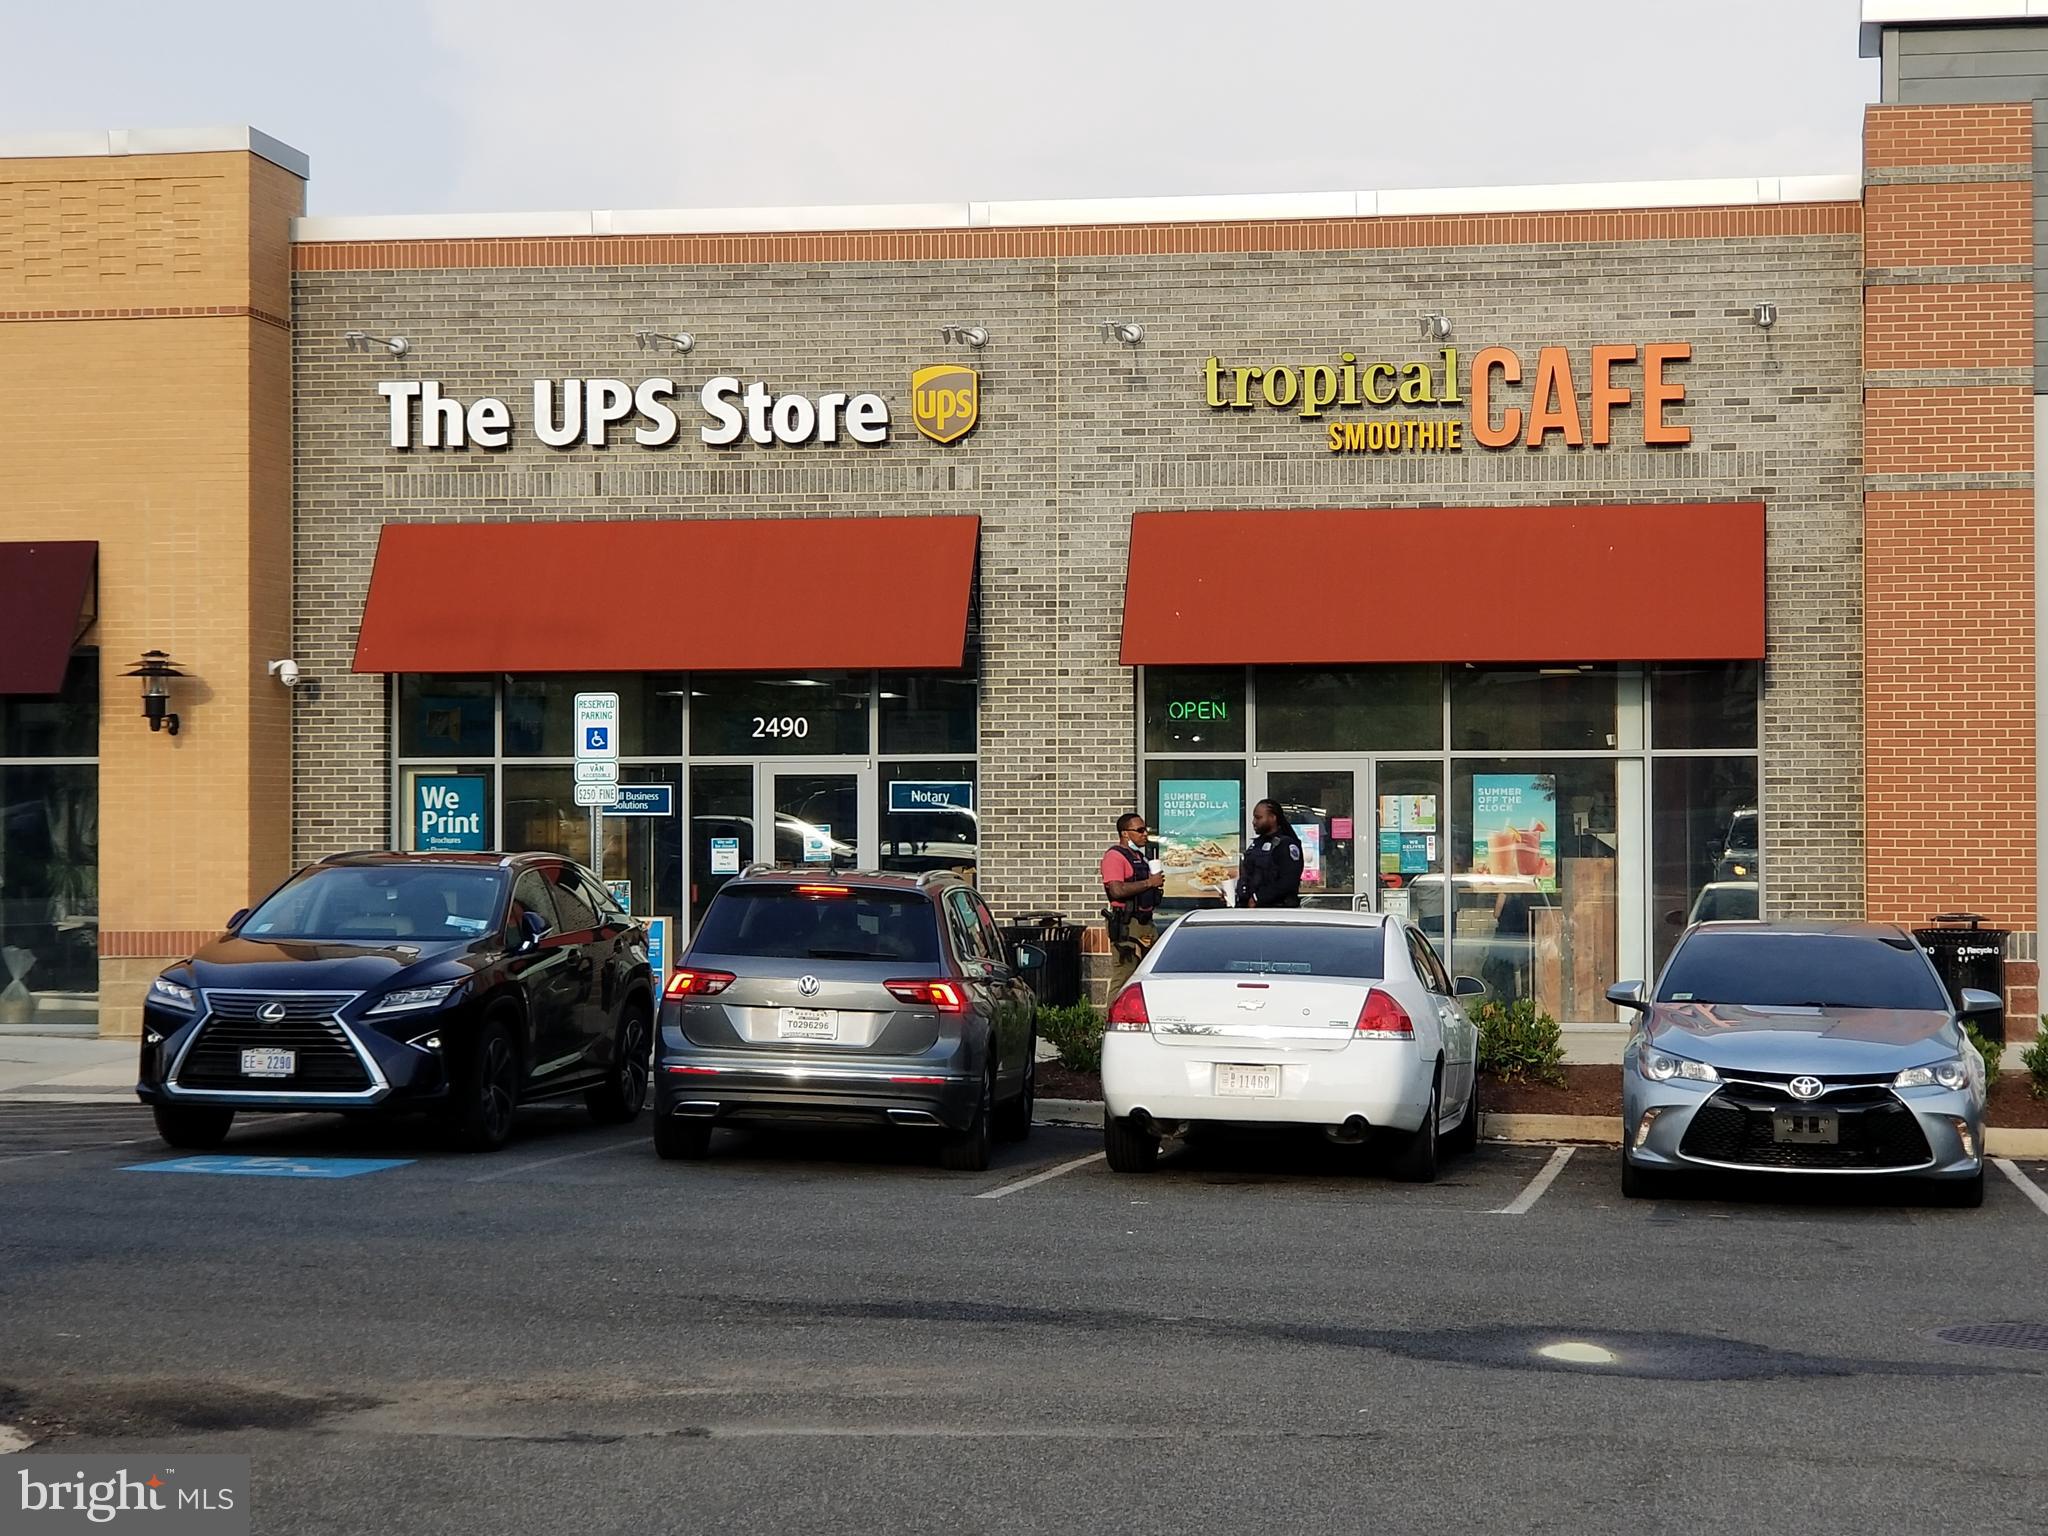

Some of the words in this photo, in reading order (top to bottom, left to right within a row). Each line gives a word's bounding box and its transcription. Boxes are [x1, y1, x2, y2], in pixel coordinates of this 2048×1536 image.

[1202, 348, 1463, 417] tropical
[1471, 343, 1692, 447] CAFE
[378, 381, 510, 447] The
[534, 378, 677, 446] UPS
[701, 377, 887, 444] Store
[918, 389, 972, 430] ups
[1329, 420, 1462, 450] SMOOTHIE
[579, 700, 615, 709] RESERVED
[1169, 701, 1226, 719] OPEN
[581, 711, 613, 720] PARKING
[752, 717, 809, 737] 2490
[421, 786, 459, 809] We
[579, 789, 596, 800] $250
[599, 788, 615, 800] FINE
[625, 791, 660, 801] Business
[911, 790, 950, 806] Notary
[1164, 792, 1207, 801] SUMMER
[1478, 788, 1522, 796] SUMMER
[613, 801, 649, 810] Solutions
[1164, 801, 1229, 809] QUESADILLA
[1478, 796, 1499, 804] OFF
[1501, 796, 1522, 804] THE
[1164, 809, 1196, 817] REMIX
[1478, 804, 1513, 812] CLOCK
[421, 811, 479, 834] Print
[1966, 947, 1993, 955] Recycle
[244, 1055, 256, 1069] EE
